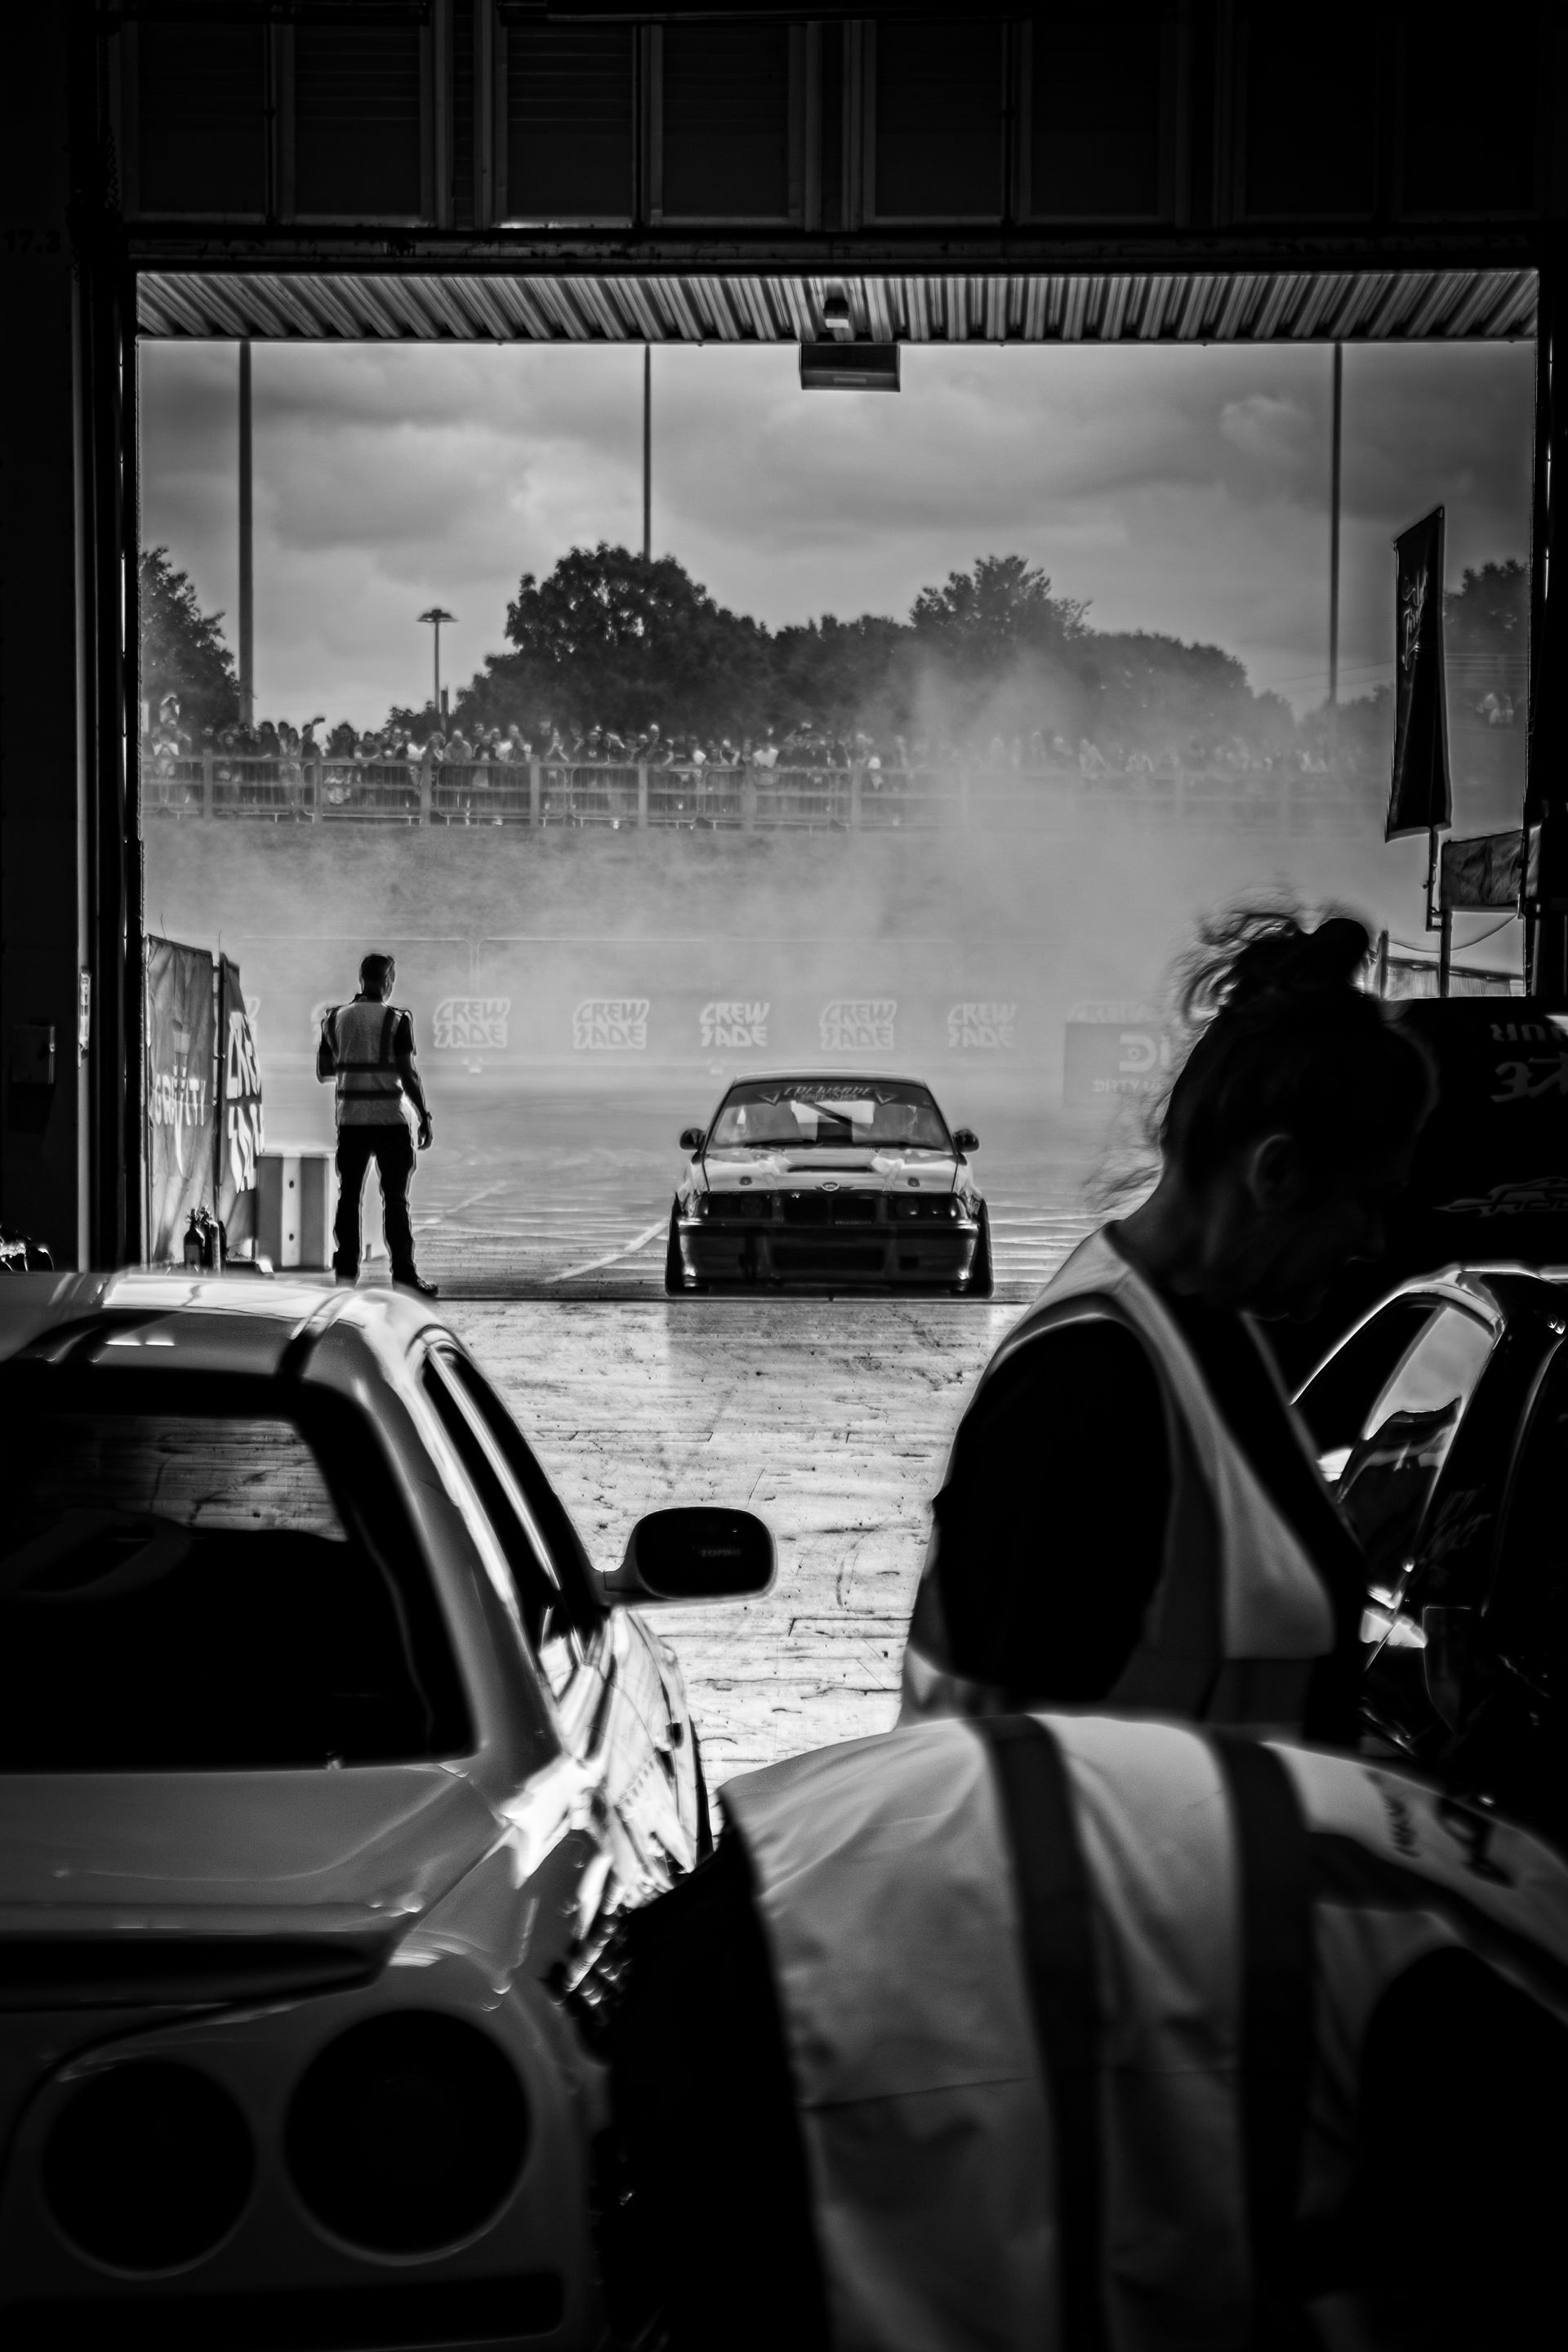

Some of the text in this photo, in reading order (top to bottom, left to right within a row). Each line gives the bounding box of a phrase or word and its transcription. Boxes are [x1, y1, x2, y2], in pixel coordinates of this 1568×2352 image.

[4, 229, 60, 253] 17.3
[433, 998, 511, 1022] CREW
[572, 999, 650, 1022] CREW
[699, 1002, 770, 1025] CREW
[819, 1000, 898, 1023] CREW
[947, 1002, 1018, 1025] CREW
